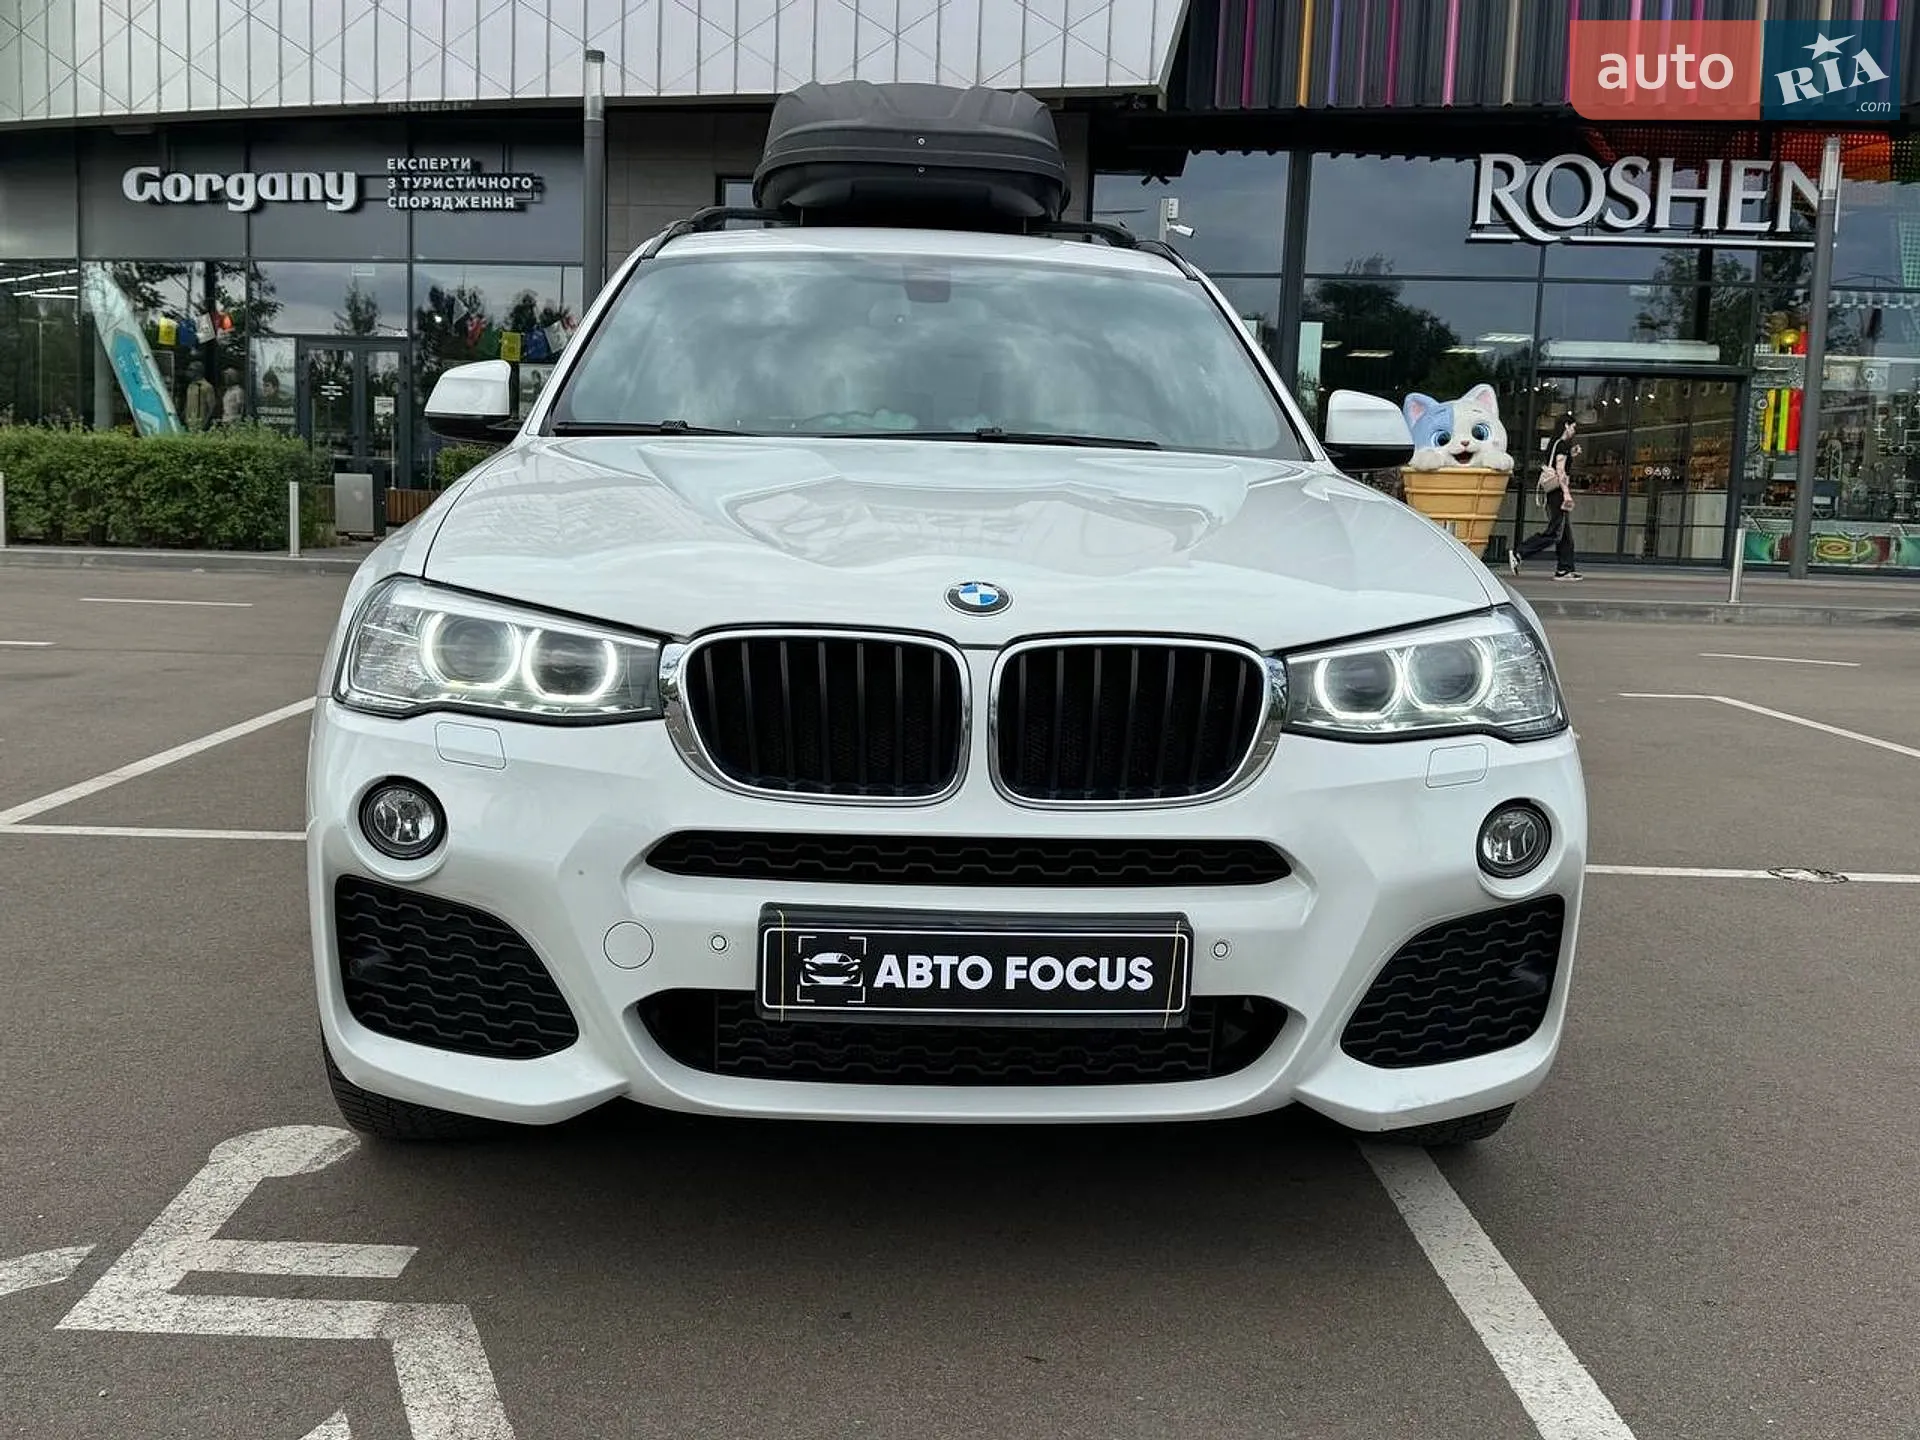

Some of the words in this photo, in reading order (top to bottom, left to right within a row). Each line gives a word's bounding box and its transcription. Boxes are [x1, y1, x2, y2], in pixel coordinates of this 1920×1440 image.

[386, 157, 472, 171] ЕКСПЕРТИ
[122, 166, 356, 212] Gorgany
[401, 176, 533, 190] ТУРИСТИЧНОГО
[386, 196, 516, 211] СПОРЯДЖЕННЯ
[1474, 152, 1844, 242] ROSHEN
[1004, 955, 1155, 992] FOCUS
